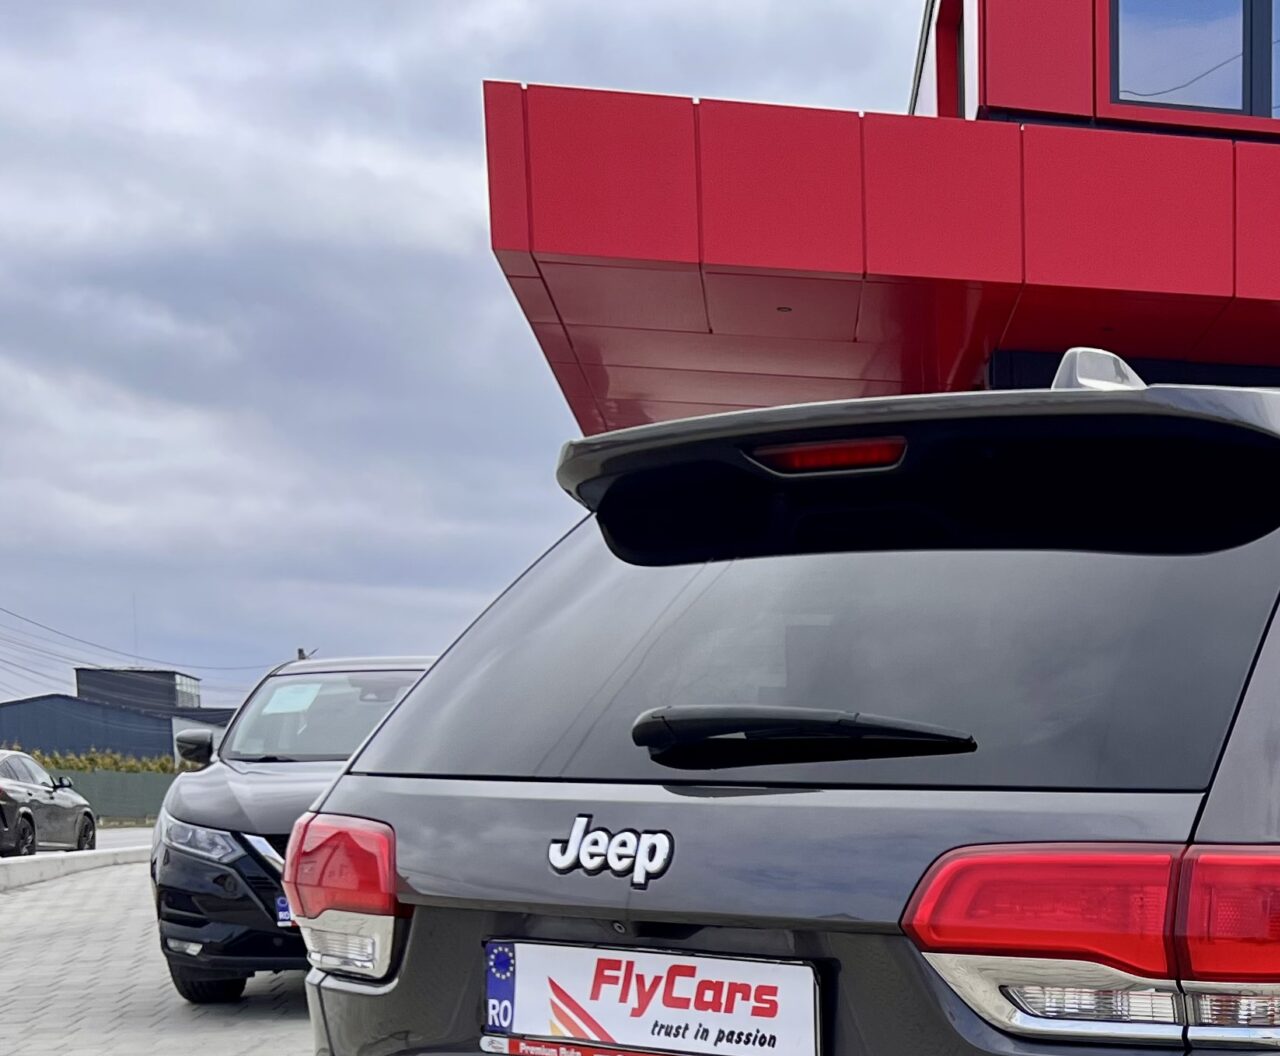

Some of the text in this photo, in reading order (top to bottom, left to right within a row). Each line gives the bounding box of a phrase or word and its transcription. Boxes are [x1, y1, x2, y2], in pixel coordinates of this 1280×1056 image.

[548, 813, 674, 890] Jeep
[589, 957, 779, 1018] FlyCars
[487, 998, 513, 1028] RO
[519, 1042, 557, 1056] Premium
[651, 1020, 777, 1049] trust in passion
